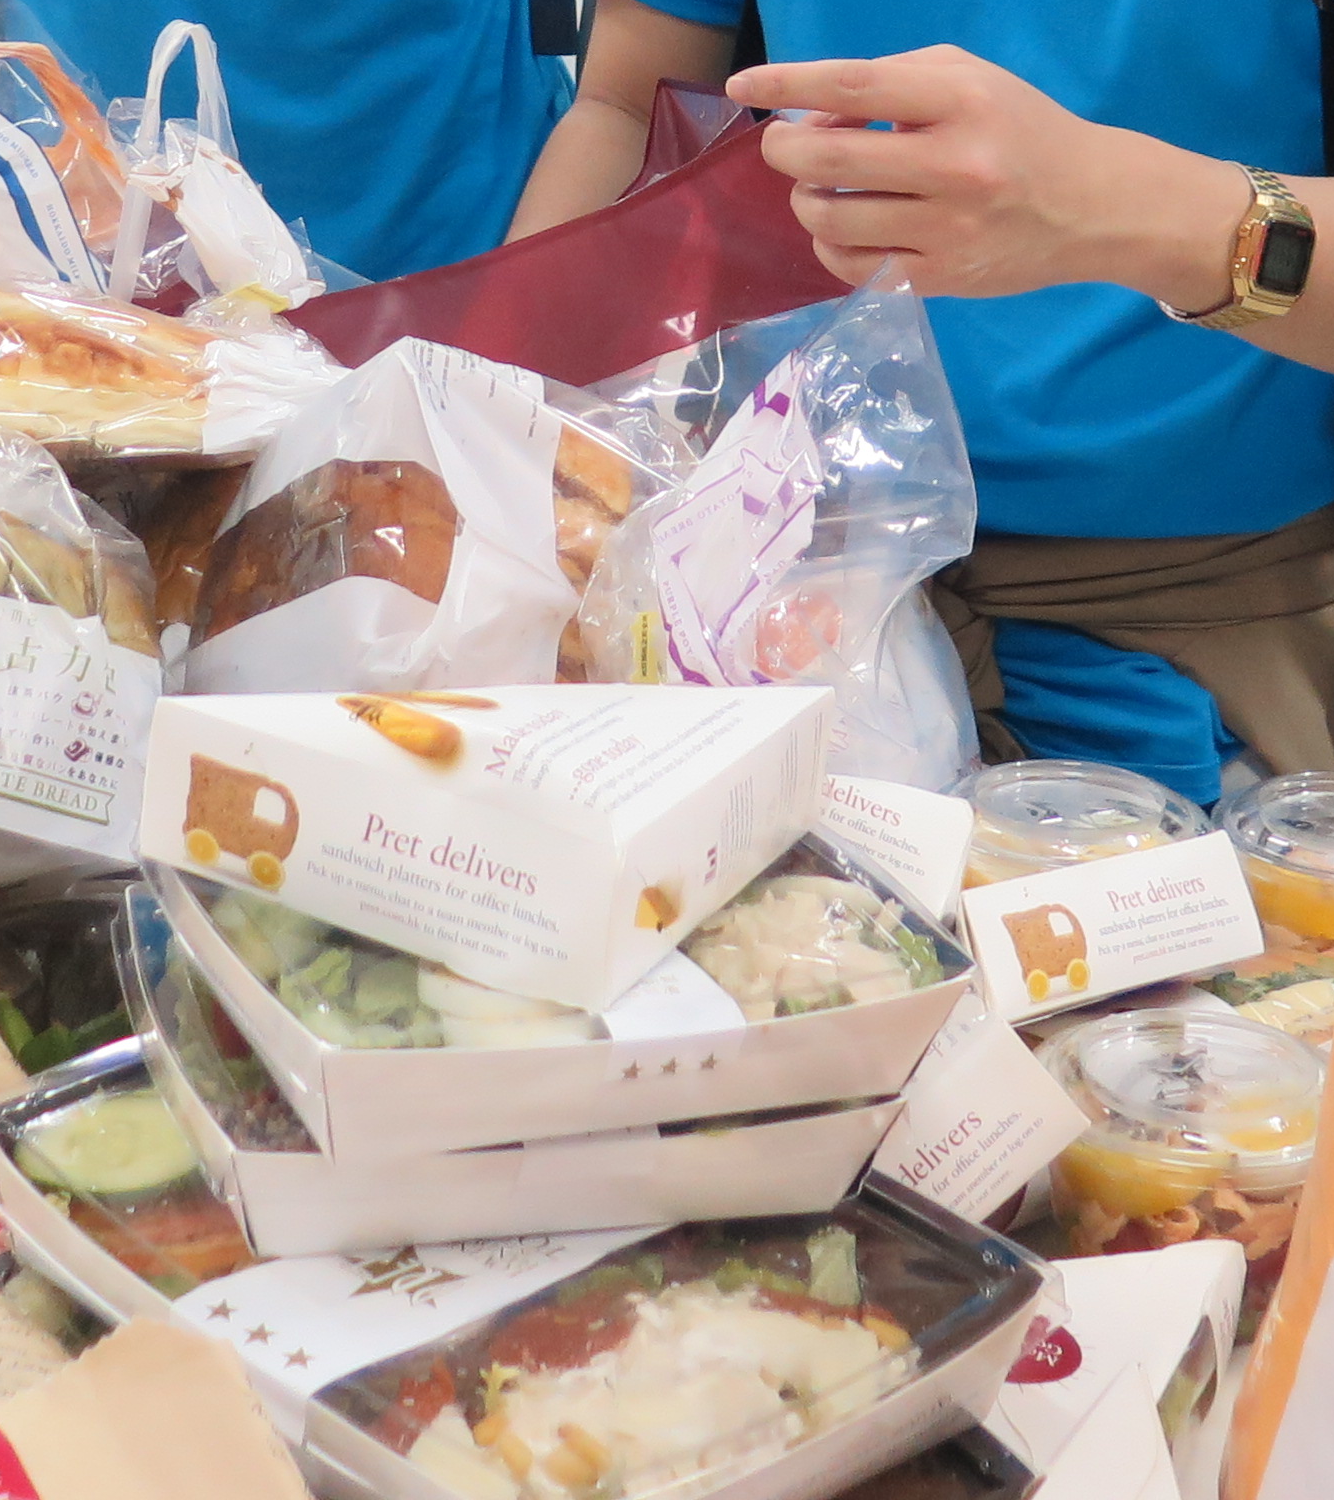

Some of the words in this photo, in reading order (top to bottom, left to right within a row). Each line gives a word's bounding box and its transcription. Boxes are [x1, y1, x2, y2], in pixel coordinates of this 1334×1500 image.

[32, 781, 99, 813] BREAD
[363, 812, 422, 858] Pret
[430, 836, 539, 896] delivers
[828, 808, 846, 823] for
[847, 818, 877, 837] office
[879, 828, 921, 856] lunches.
[321, 843, 385, 874] sandwich
[388, 864, 441, 892] platters
[446, 881, 468, 899] for
[471, 891, 510, 914] office
[513, 901, 559, 933] lunches.
[331, 871, 344, 886] up
[414, 899, 425, 912] to
[1106, 890, 1146, 913] Pret
[1147, 876, 1207, 904] delivers
[931, 1180, 951, 1196] for
[951, 1149, 980, 1177] office
[978, 1110, 1023, 1151] lunches.
[967, 1160, 999, 1193] member
